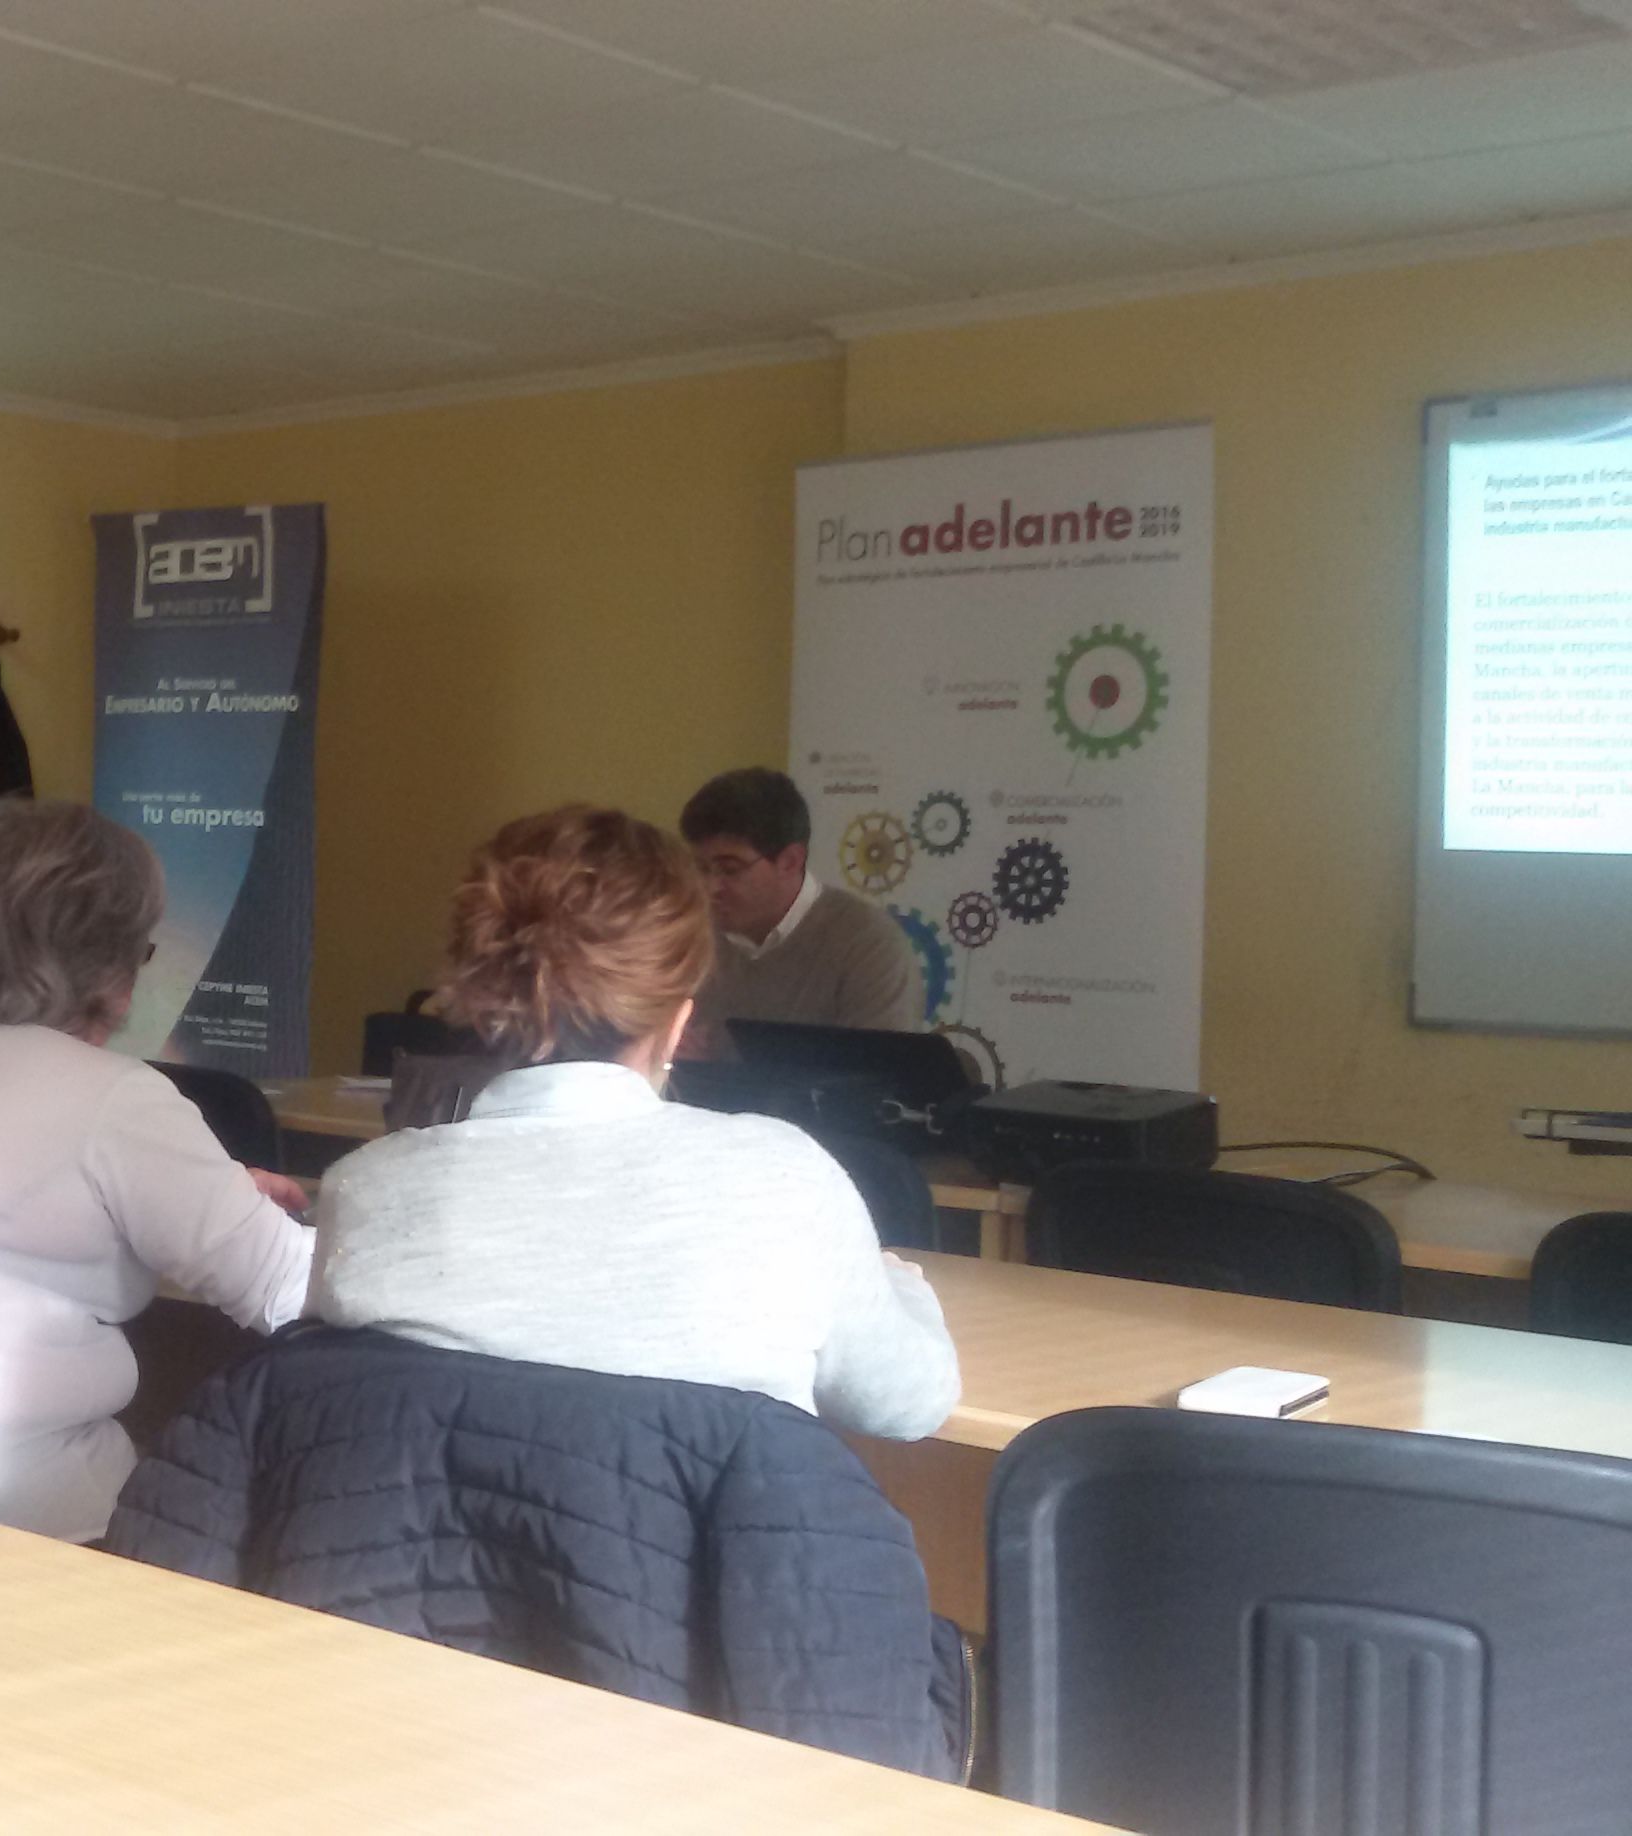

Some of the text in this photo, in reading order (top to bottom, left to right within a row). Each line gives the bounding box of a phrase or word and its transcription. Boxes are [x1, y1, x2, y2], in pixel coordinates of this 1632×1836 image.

[1484, 473, 1539, 493] Ayudas
[1544, 474, 1577, 490] para
[1510, 497, 1581, 514] empresas
[1587, 496, 1606, 507] en
[816, 499, 1182, 563] Plan adelante 2016
[1139, 521, 1182, 539] 2019
[1484, 521, 1549, 536] industria
[1474, 592, 1492, 608] El
[143, 804, 265, 833] tu empresa
[1007, 813, 1068, 825] adelante
[1010, 990, 1072, 1005] adelante
